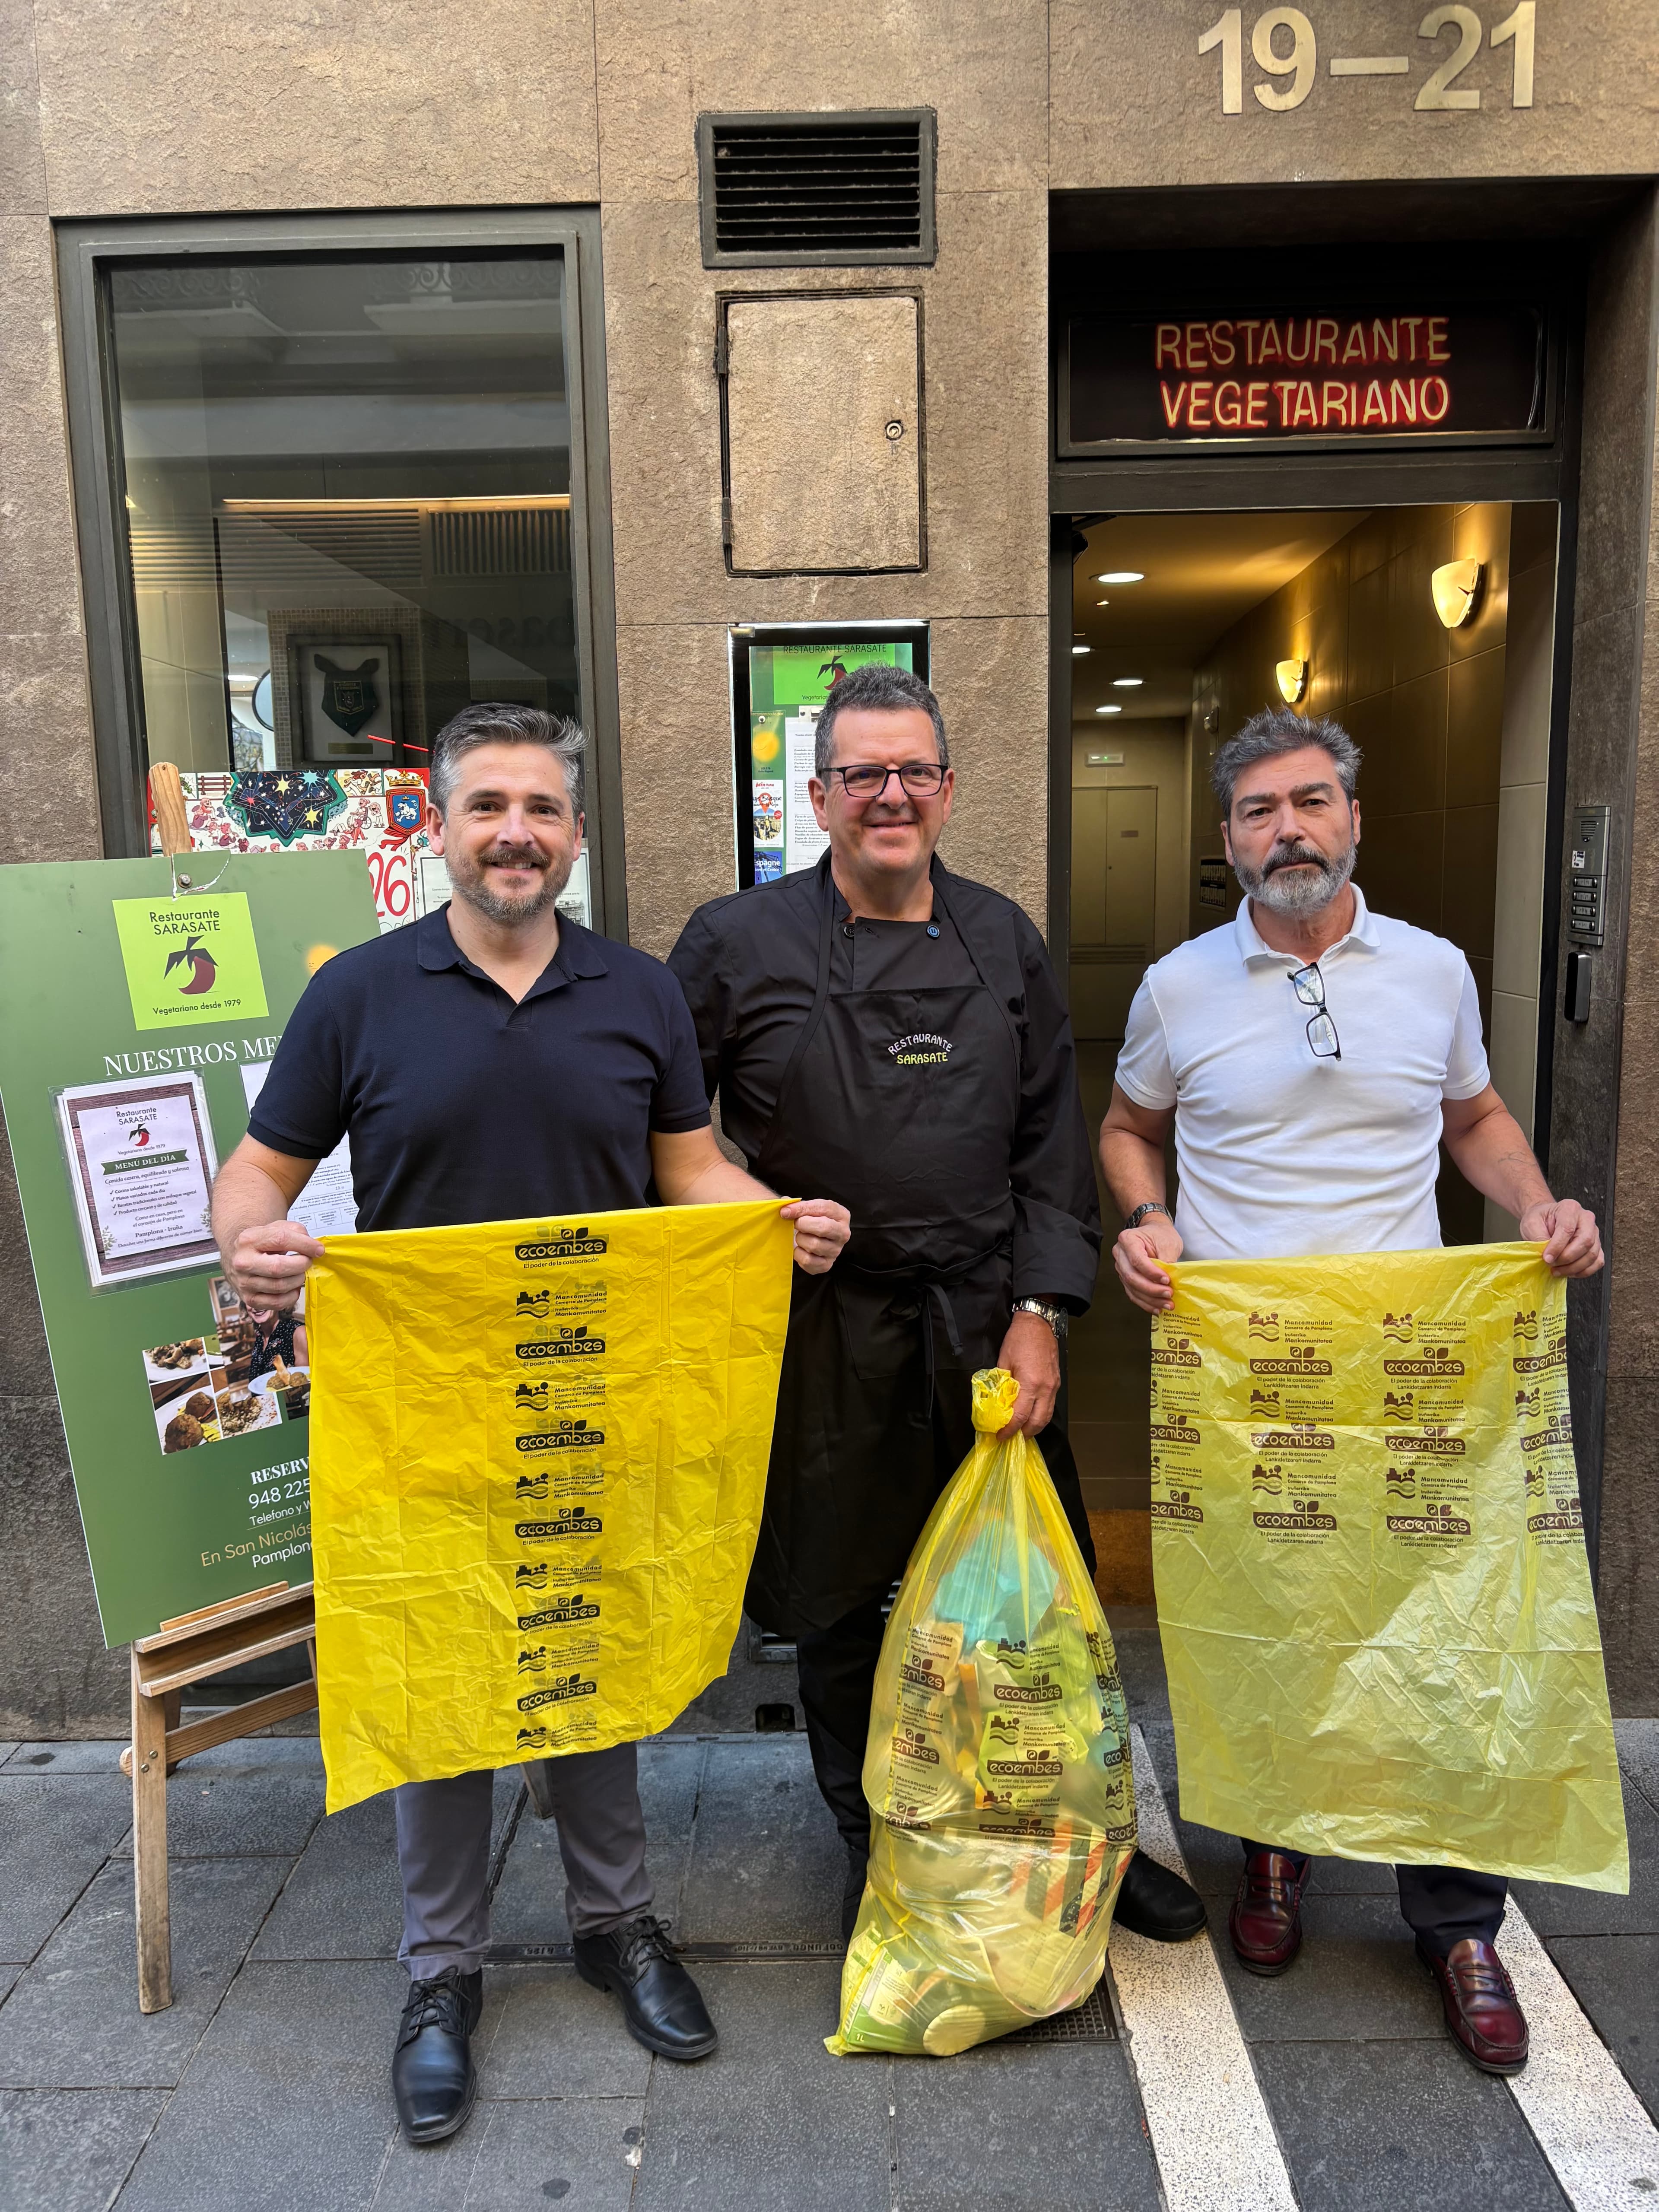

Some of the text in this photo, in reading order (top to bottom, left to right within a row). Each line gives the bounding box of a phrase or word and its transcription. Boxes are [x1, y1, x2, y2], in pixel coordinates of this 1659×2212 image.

[1156, 317, 1451, 369] RESTAURANTE
[1160, 376, 1450, 428] VEGETARIANO
[783, 644, 887, 654] RESTAURANTE SARASATE
[149, 909, 220, 922] Restaurante
[154, 920, 221, 935] SARASATE
[153, 999, 241, 1015] Vegetariano desde 1979
[888, 1033, 953, 1055] RESTAURANTE
[103, 1036, 282, 1076] NUESTROS ME
[896, 1052, 948, 1065] SARASATE
[116, 1107, 157, 1118] Restaurante
[119, 1114, 157, 1125] SARASATE
[115, 1160, 140, 1170] MENÚ
[142, 1157, 159, 1166] DEL
[141, 1170, 167, 1178] equilibrada
[135, 1230, 163, 1238] Pamplona
[518, 1240, 604, 1258] ecoembes
[556, 1291, 607, 1300] Mancomunidad
[519, 1341, 602, 1356] ecoembes
[1253, 1361, 1329, 1373] ecoembes
[1386, 1362, 1462, 1373] ecoembes
[555, 1384, 605, 1393] Mancomunidad
[555, 1402, 605, 1410] Mankomunitatea
[519, 1433, 601, 1449] ecoembes
[1255, 1435, 1332, 1446] ecoembes
[1389, 1438, 1462, 1450] ecoembes
[1524, 1430, 1573, 1449] ecoemb
[554, 1473, 604, 1482] Mancomunidad
[248, 1487, 281, 1509] 948
[249, 1507, 294, 1526] Telefono
[296, 1504, 302, 1514] y
[1256, 1515, 1334, 1527] ecoembes
[518, 1519, 599, 1535] ecoembes
[1390, 1519, 1468, 1531] ecoembes
[201, 1522, 312, 1567] En San Nicolás
[252, 1542, 313, 1567] Pamplon
[553, 1578, 601, 1588] Mankomunitatea
[521, 1606, 597, 1628] ecoembes
[551, 1643, 599, 1654] Mancomunidad
[551, 1658, 598, 1669] Mankomunitatea
[521, 1683, 593, 1709] ecoembes
[996, 1686, 1060, 1700] ecoembes
[552, 1721, 597, 1734] Mancomunidad
[990, 1761, 1060, 1773] ecoembes
[856, 2033, 864, 2042] 1L
